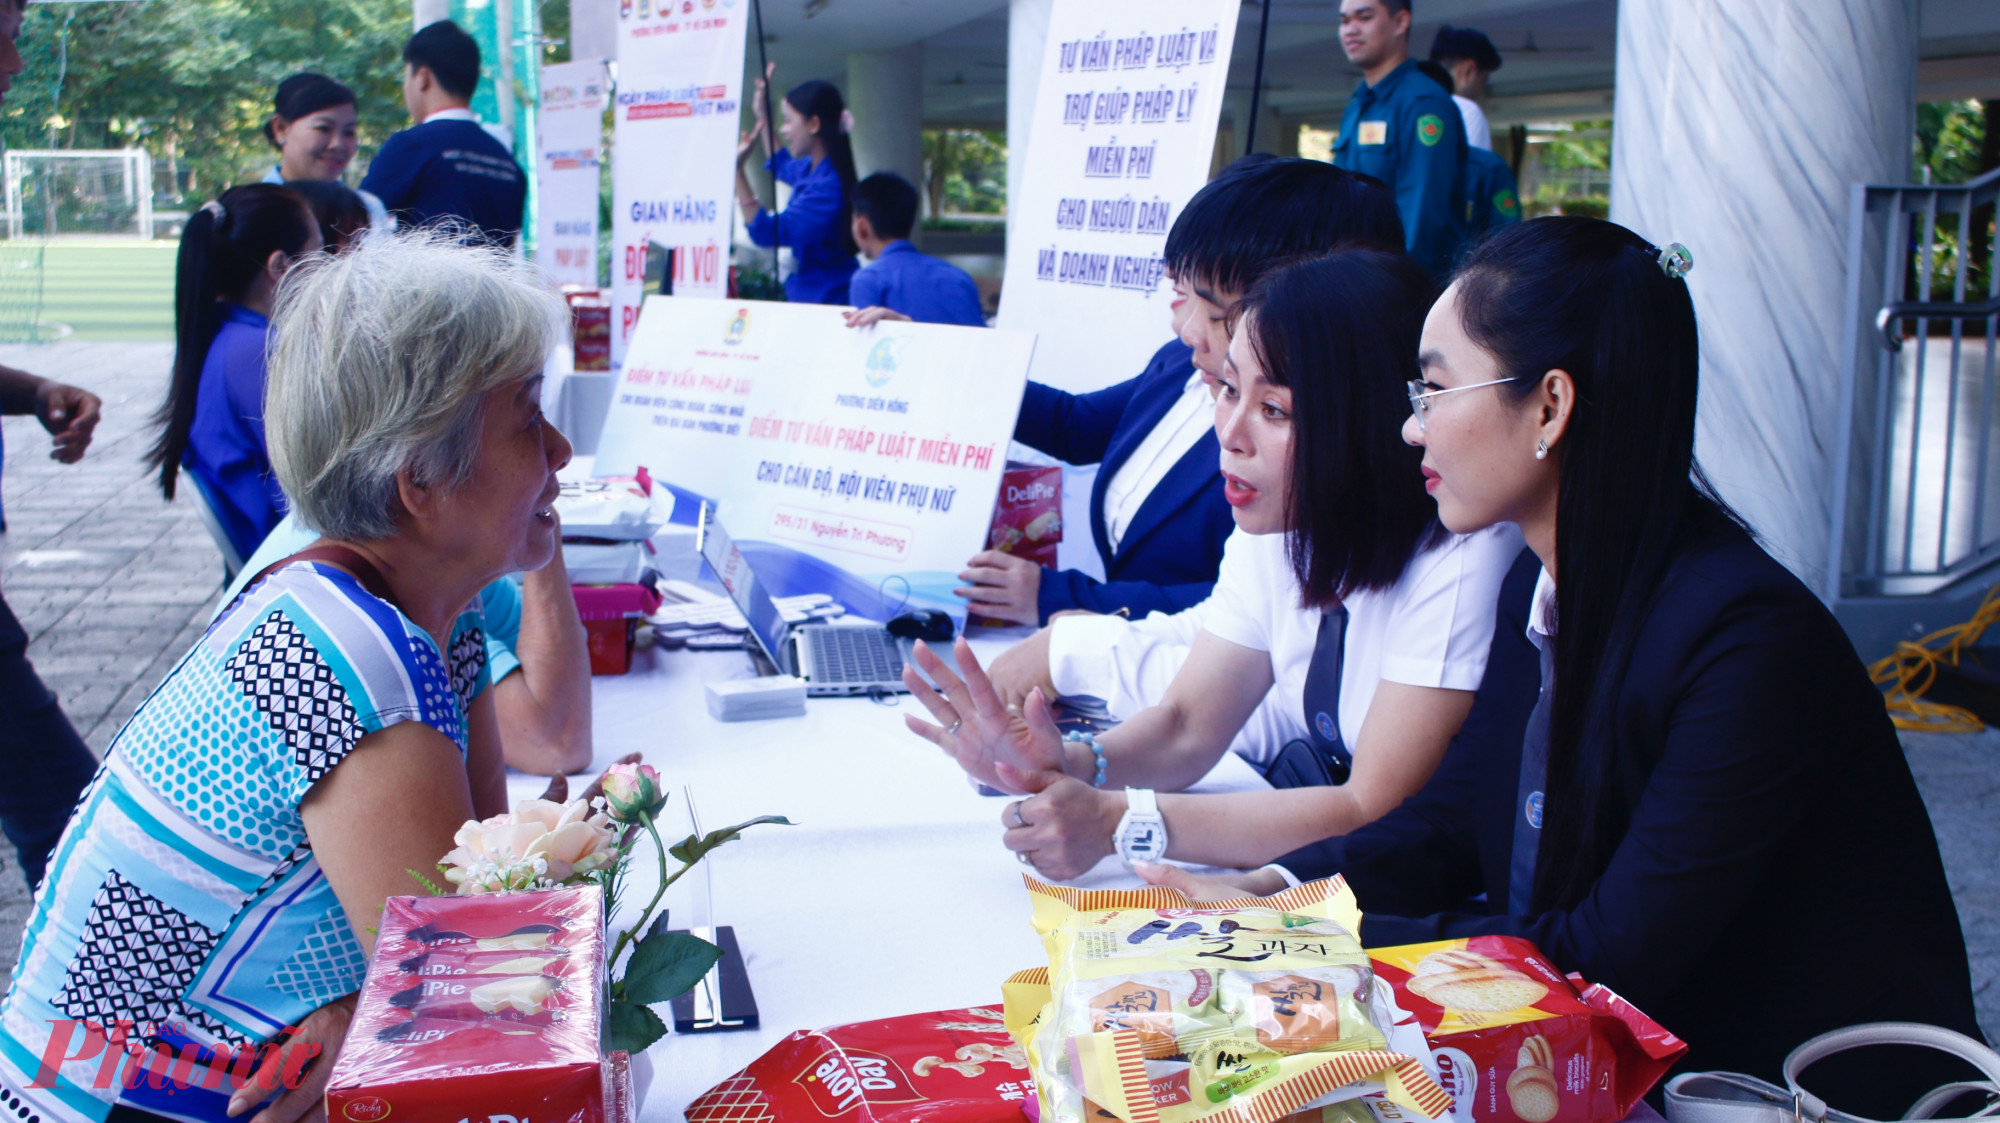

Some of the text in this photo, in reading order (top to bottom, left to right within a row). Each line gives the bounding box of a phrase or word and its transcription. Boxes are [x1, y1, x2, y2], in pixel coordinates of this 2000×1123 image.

[1059, 38, 1080, 70] TƯ
[1081, 31, 1112, 70] VẤN
[1114, 31, 1154, 68] PHÁP
[1156, 27, 1198, 72] LUẬT
[1064, 82, 1198, 130] TRỢ GIÚP PHÁP LÝ
[1085, 136, 1157, 177] MIỄN PHÍ
[631, 195, 717, 223] GIAN HÀNG
[1056, 193, 1170, 234] CHO NGƯỜI DÂN
[1037, 244, 1056, 279] VÀ
[1059, 251, 1110, 285] DOANH
[748, 409, 996, 472] ĐIỂM TƯ VẤN PHÁP LUẬT MIỄN PHÍ
[756, 460, 783, 484] CHO
[783, 460, 810, 490] CÁN
[836, 470, 861, 498] HỘI
[862, 471, 896, 503] VIÊN
[897, 482, 929, 517] PHỤ
[929, 483, 958, 514] NỮ
[1006, 482, 1055, 503] DeliPie
[816, 1057, 862, 1111] Love
[850, 1056, 897, 1091] Day
[1150, 1080, 1173, 1093] OW
[1487, 1065, 1497, 1113] BÁNH QUY SỮA
[1565, 1058, 1574, 1092] Delicious
[1573, 1051, 1581, 1096] milk biscuits
[352, 1099, 382, 1118] Richy
[1153, 1092, 1178, 1105] KER
